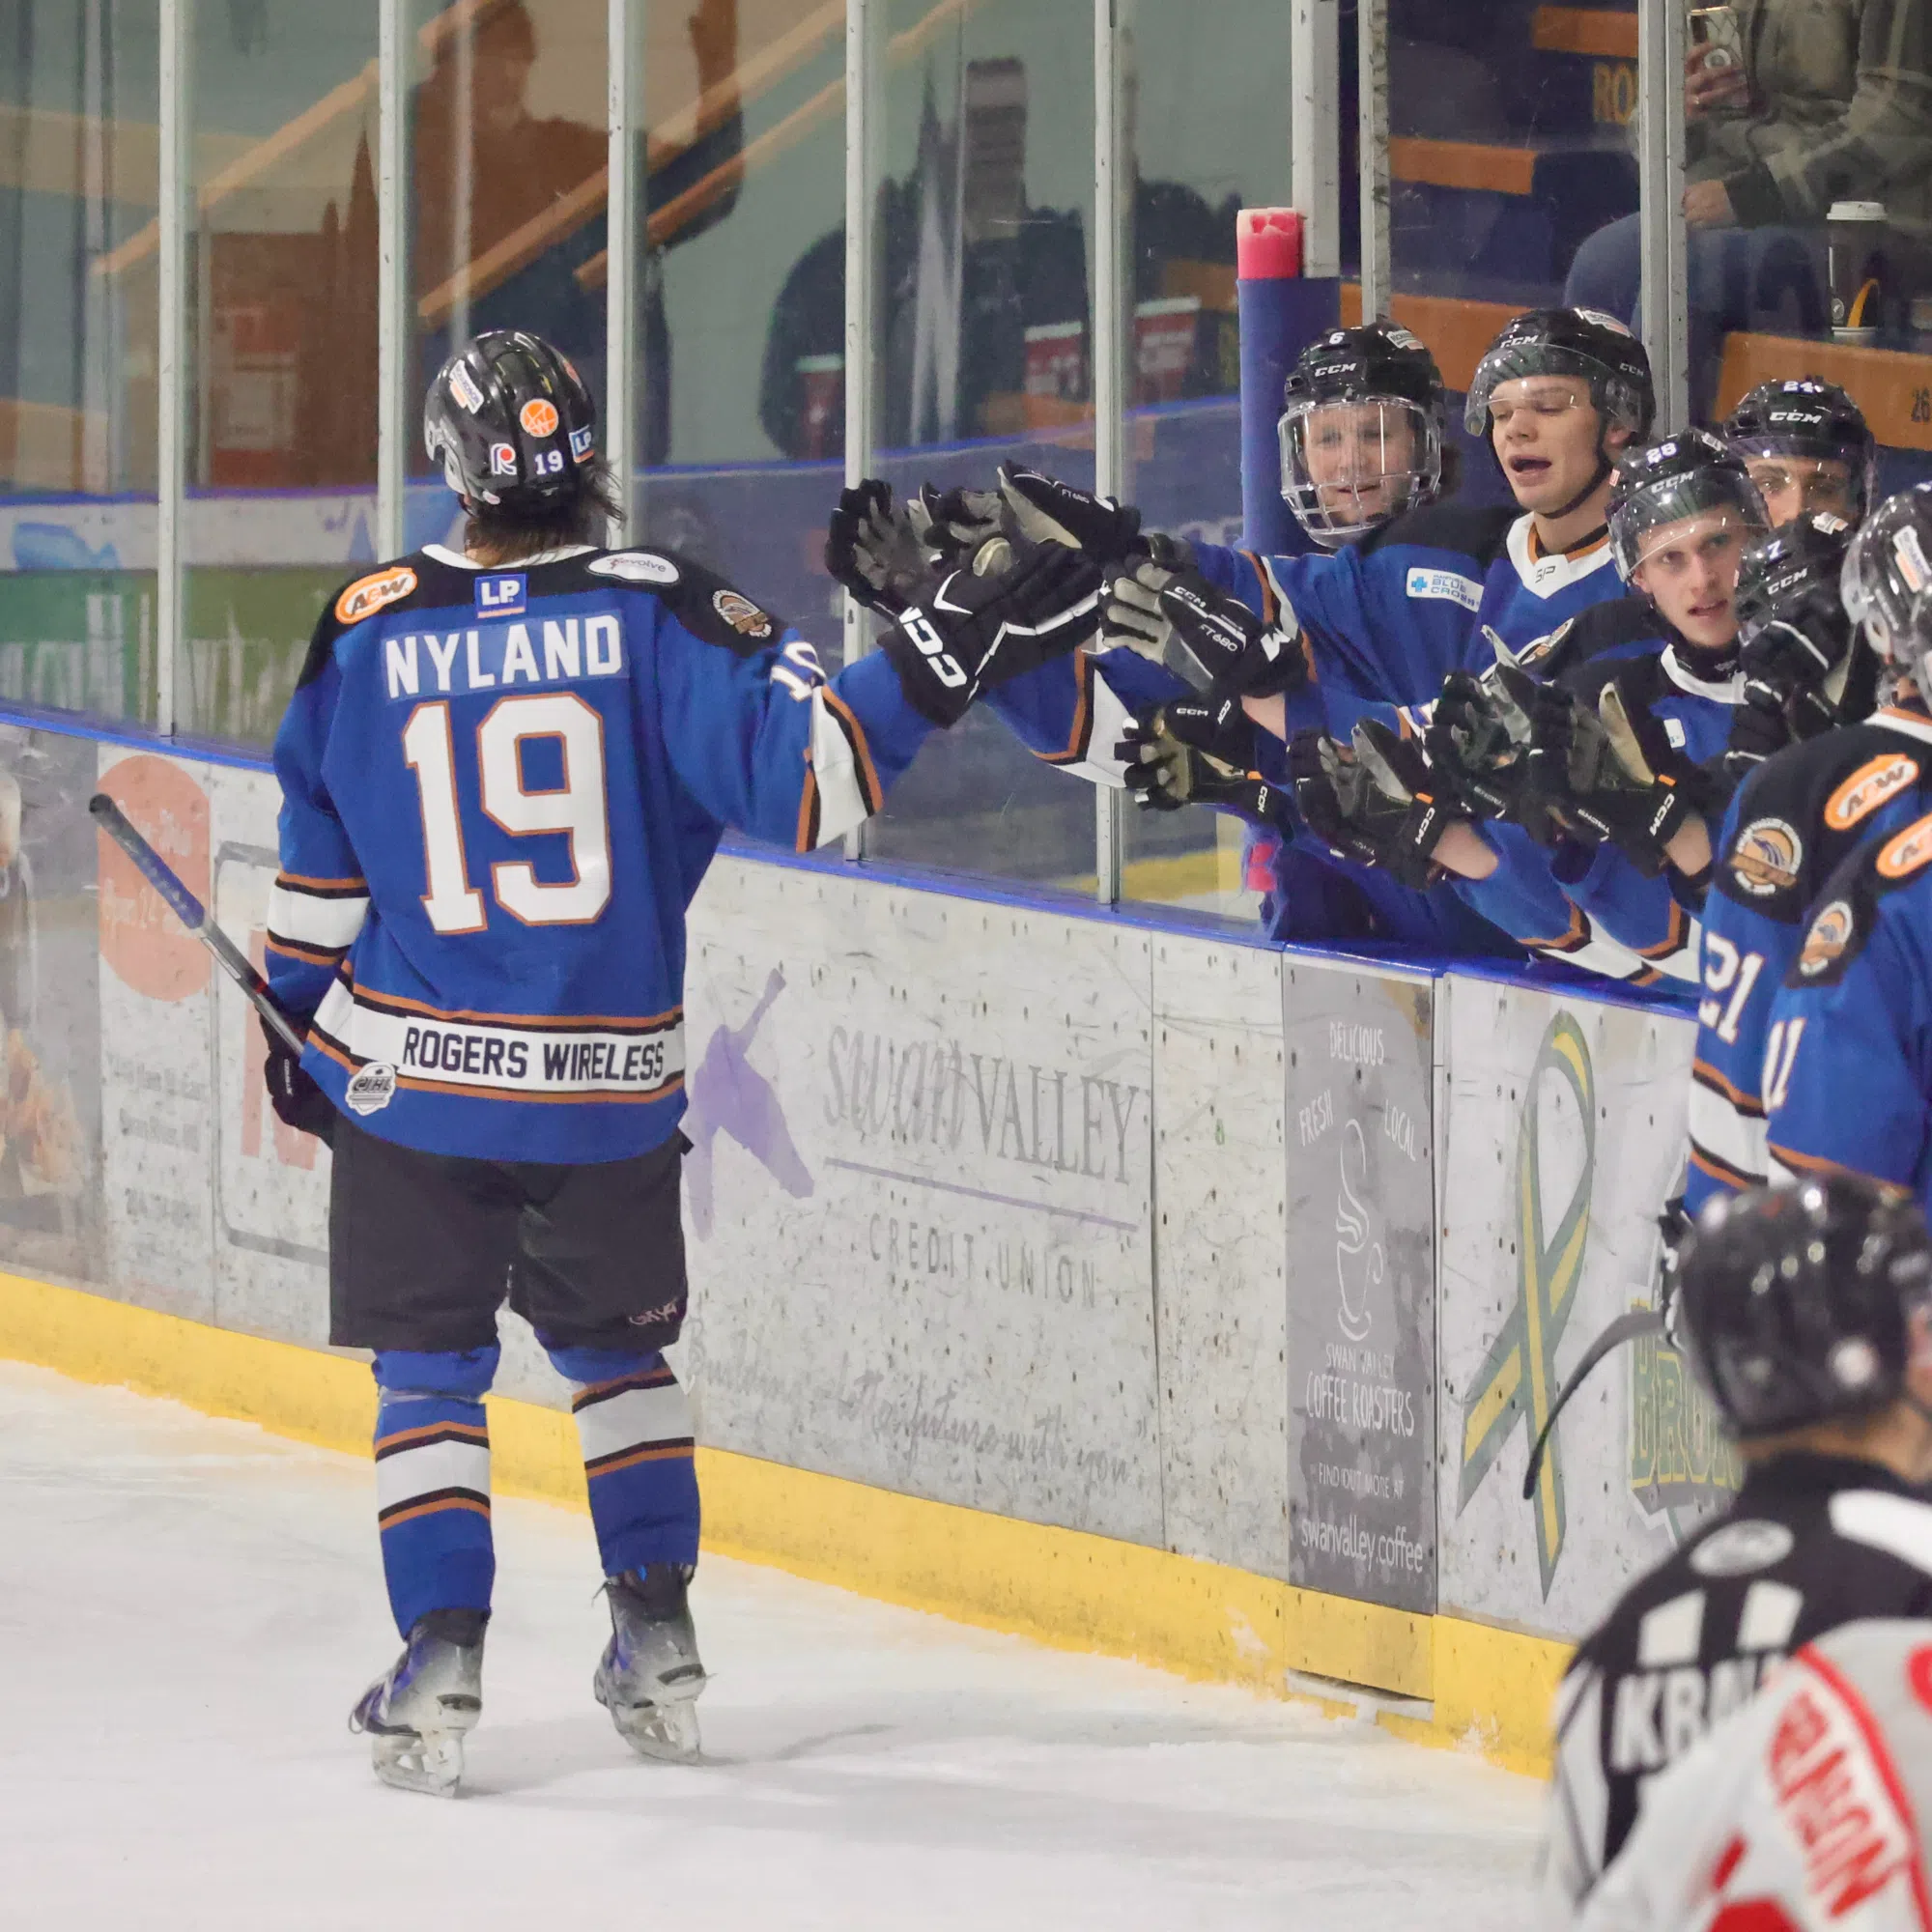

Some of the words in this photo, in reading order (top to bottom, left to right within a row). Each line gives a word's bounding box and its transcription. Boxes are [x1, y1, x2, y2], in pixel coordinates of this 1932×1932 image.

[1328, 331, 1346, 345] 6
[1500, 335, 1539, 349] CCM
[1314, 362, 1357, 378] CCM
[1619, 362, 1644, 377] CCM
[1783, 381, 1814, 394] 24
[1769, 411, 1823, 424] CCM
[534, 449, 564, 475] 19
[1651, 469, 1695, 494] CCM
[1767, 540, 1785, 560] 7
[480, 580, 521, 607] LP
[1432, 579, 1466, 594] BLUE
[1767, 568, 1808, 595] CCM
[1174, 585, 1207, 610] CCM
[1431, 586, 1476, 607] CROSS
[384, 614, 623, 699] NYLAND
[1176, 706, 1208, 717] CCM
[402, 691, 615, 936] 19
[1649, 792, 1675, 837] CCM
[1697, 930, 1765, 1047] 21
[402, 1026, 529, 1079] ROGERS
[543, 1040, 665, 1083] WIRELESS
[1329, 1021, 1384, 1067] DELICIOUS
[1298, 1089, 1334, 1148] FRESH
[1384, 1098, 1416, 1163] LOCAL
[869, 1212, 974, 1280] CREDIT
[997, 1238, 1095, 1308] UNION
[1325, 1343, 1357, 1373] SWAN
[1306, 1371, 1349, 1425] COFFEE
[1352, 1382, 1415, 1438] ROASTERS
[1319, 1462, 1340, 1489] FIND
[1342, 1468, 1362, 1492] OUT
[1365, 1473, 1390, 1496] MORE
[1300, 1515, 1423, 1574] swanvalley.coffee
